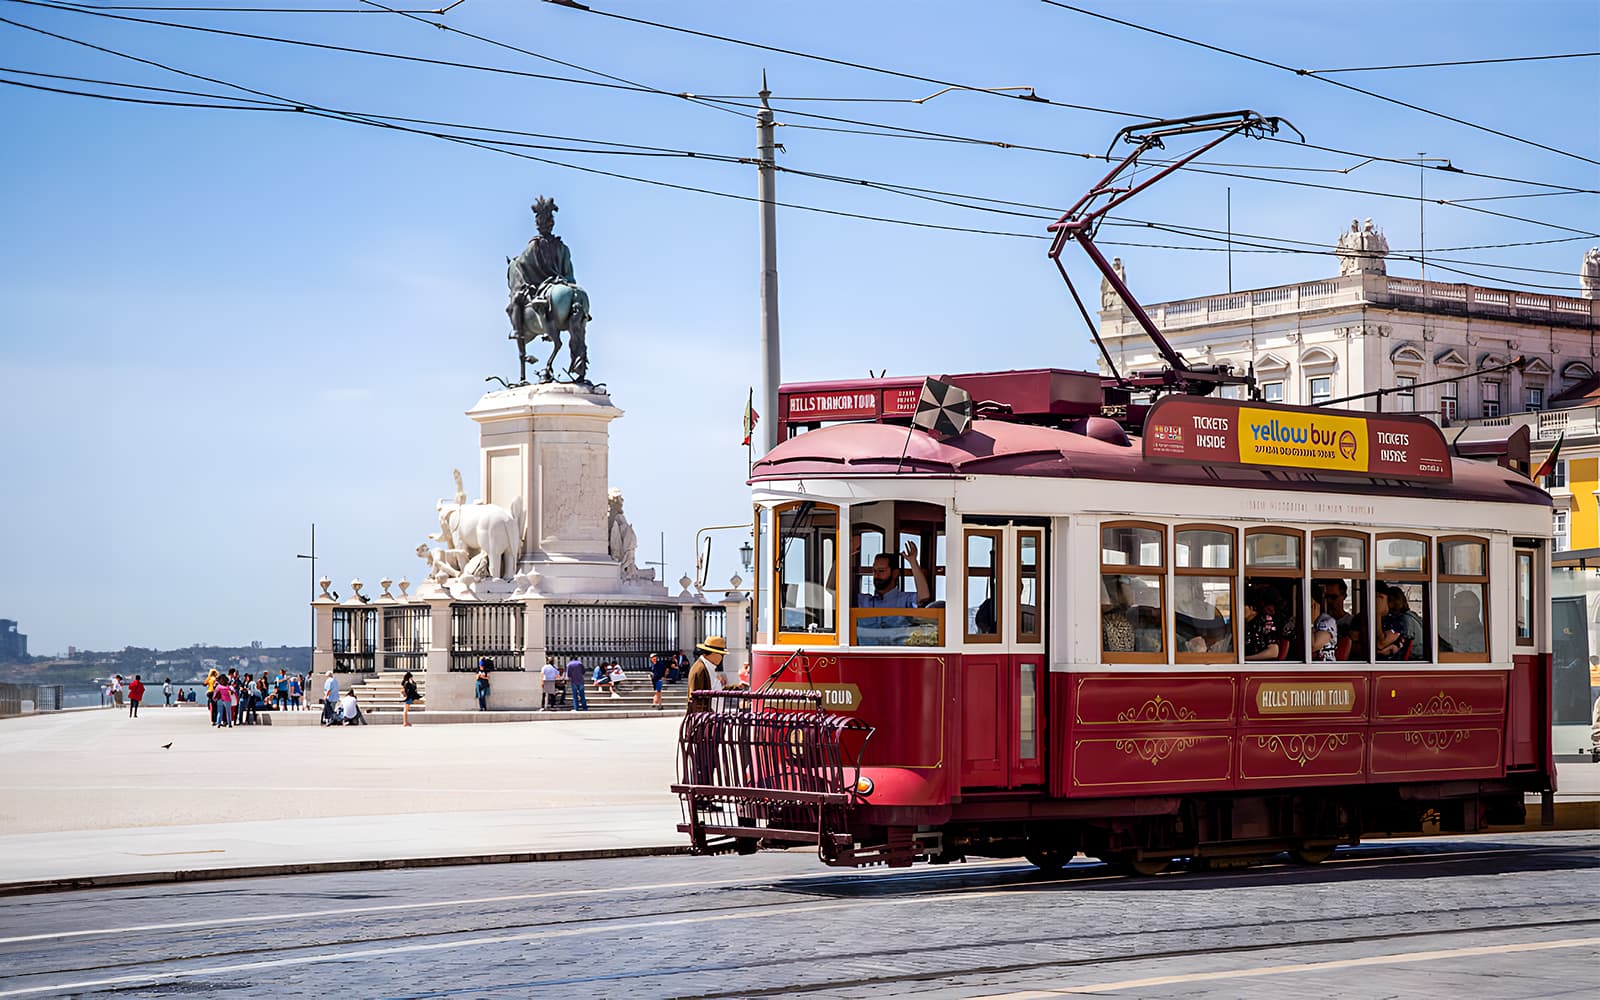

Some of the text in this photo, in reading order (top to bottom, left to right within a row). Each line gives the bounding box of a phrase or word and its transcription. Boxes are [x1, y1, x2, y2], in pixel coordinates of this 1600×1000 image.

[1192, 415, 1229, 431] TICKETS
[1196, 434, 1226, 449] INSIDE
[1376, 431, 1410, 446] TICKETS
[825, 690, 853, 705] TOUR
[1262, 690, 1288, 707] HILLS
